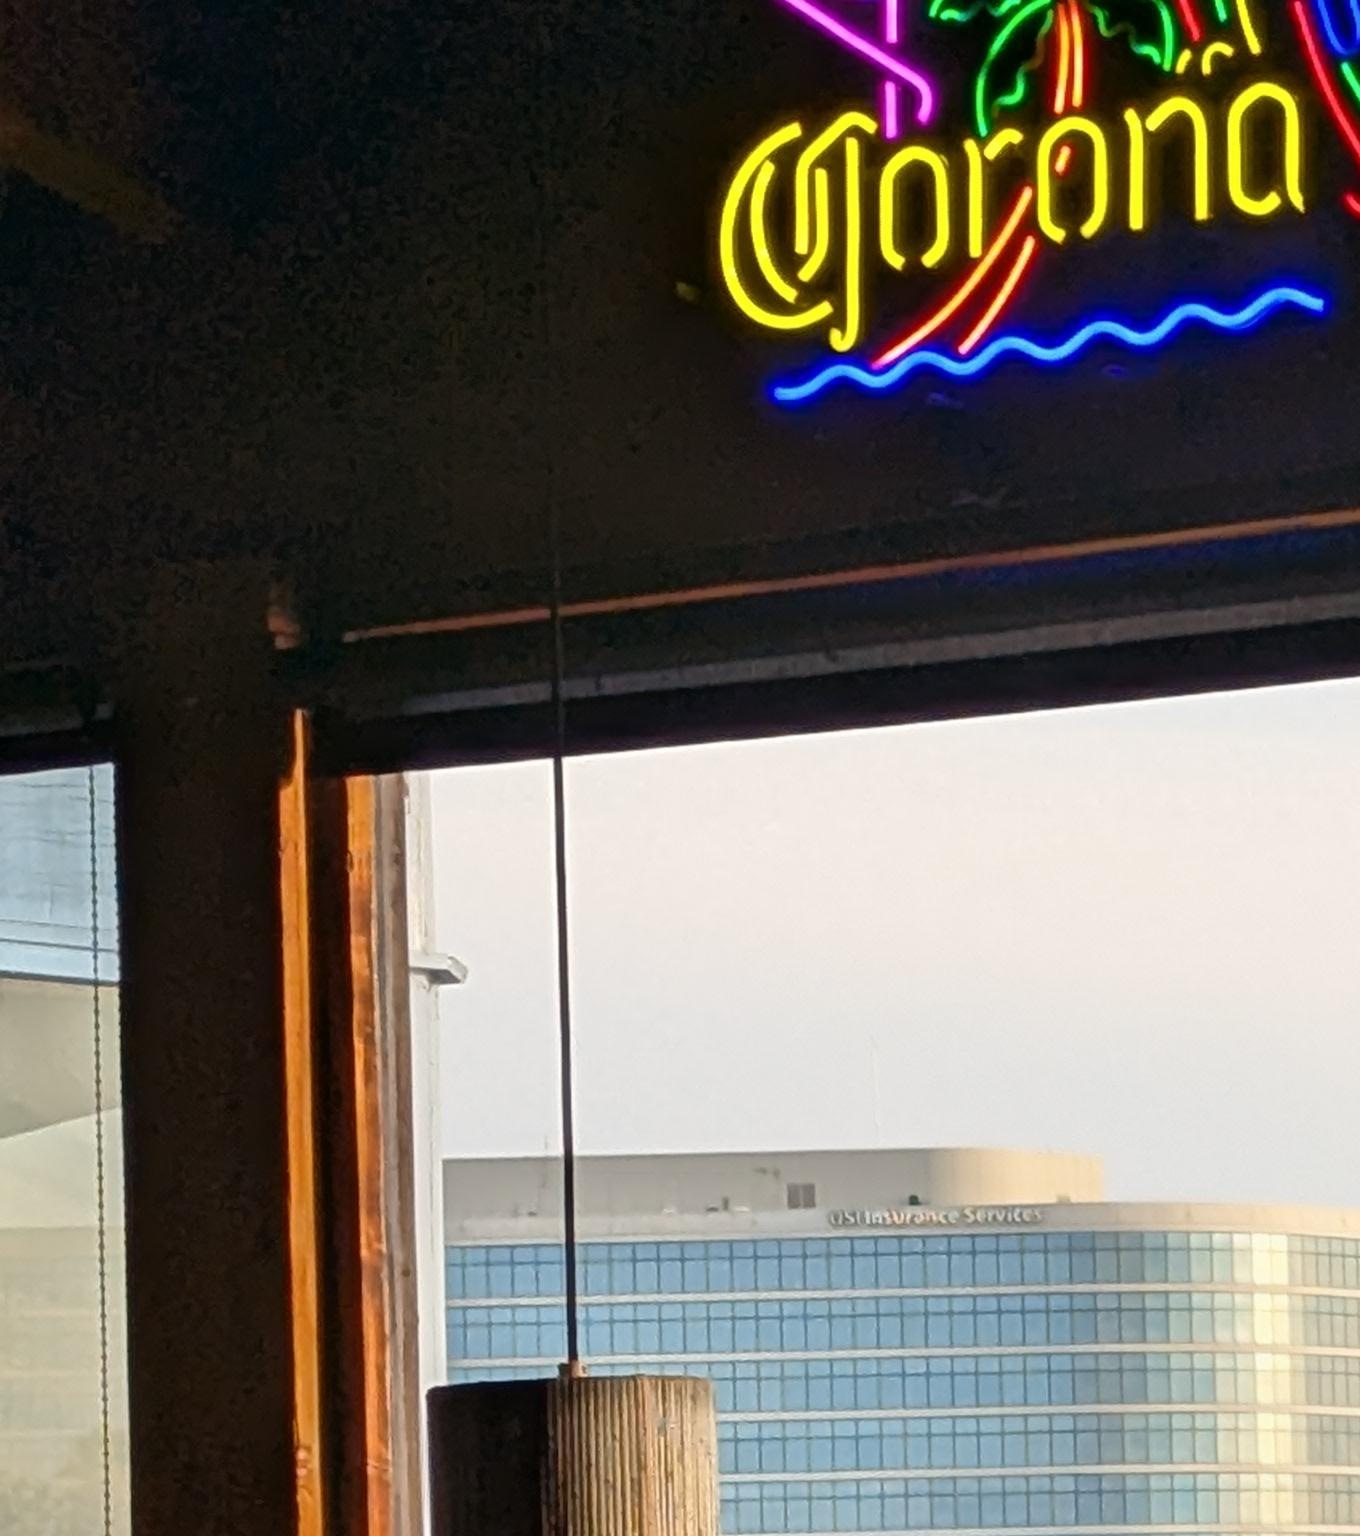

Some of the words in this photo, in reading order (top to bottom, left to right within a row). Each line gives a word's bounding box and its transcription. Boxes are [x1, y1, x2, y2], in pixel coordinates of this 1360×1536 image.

[719, 81, 1305, 353] Corona
[864, 1208, 960, 1226] Insurance
[963, 1206, 1042, 1224] Services
